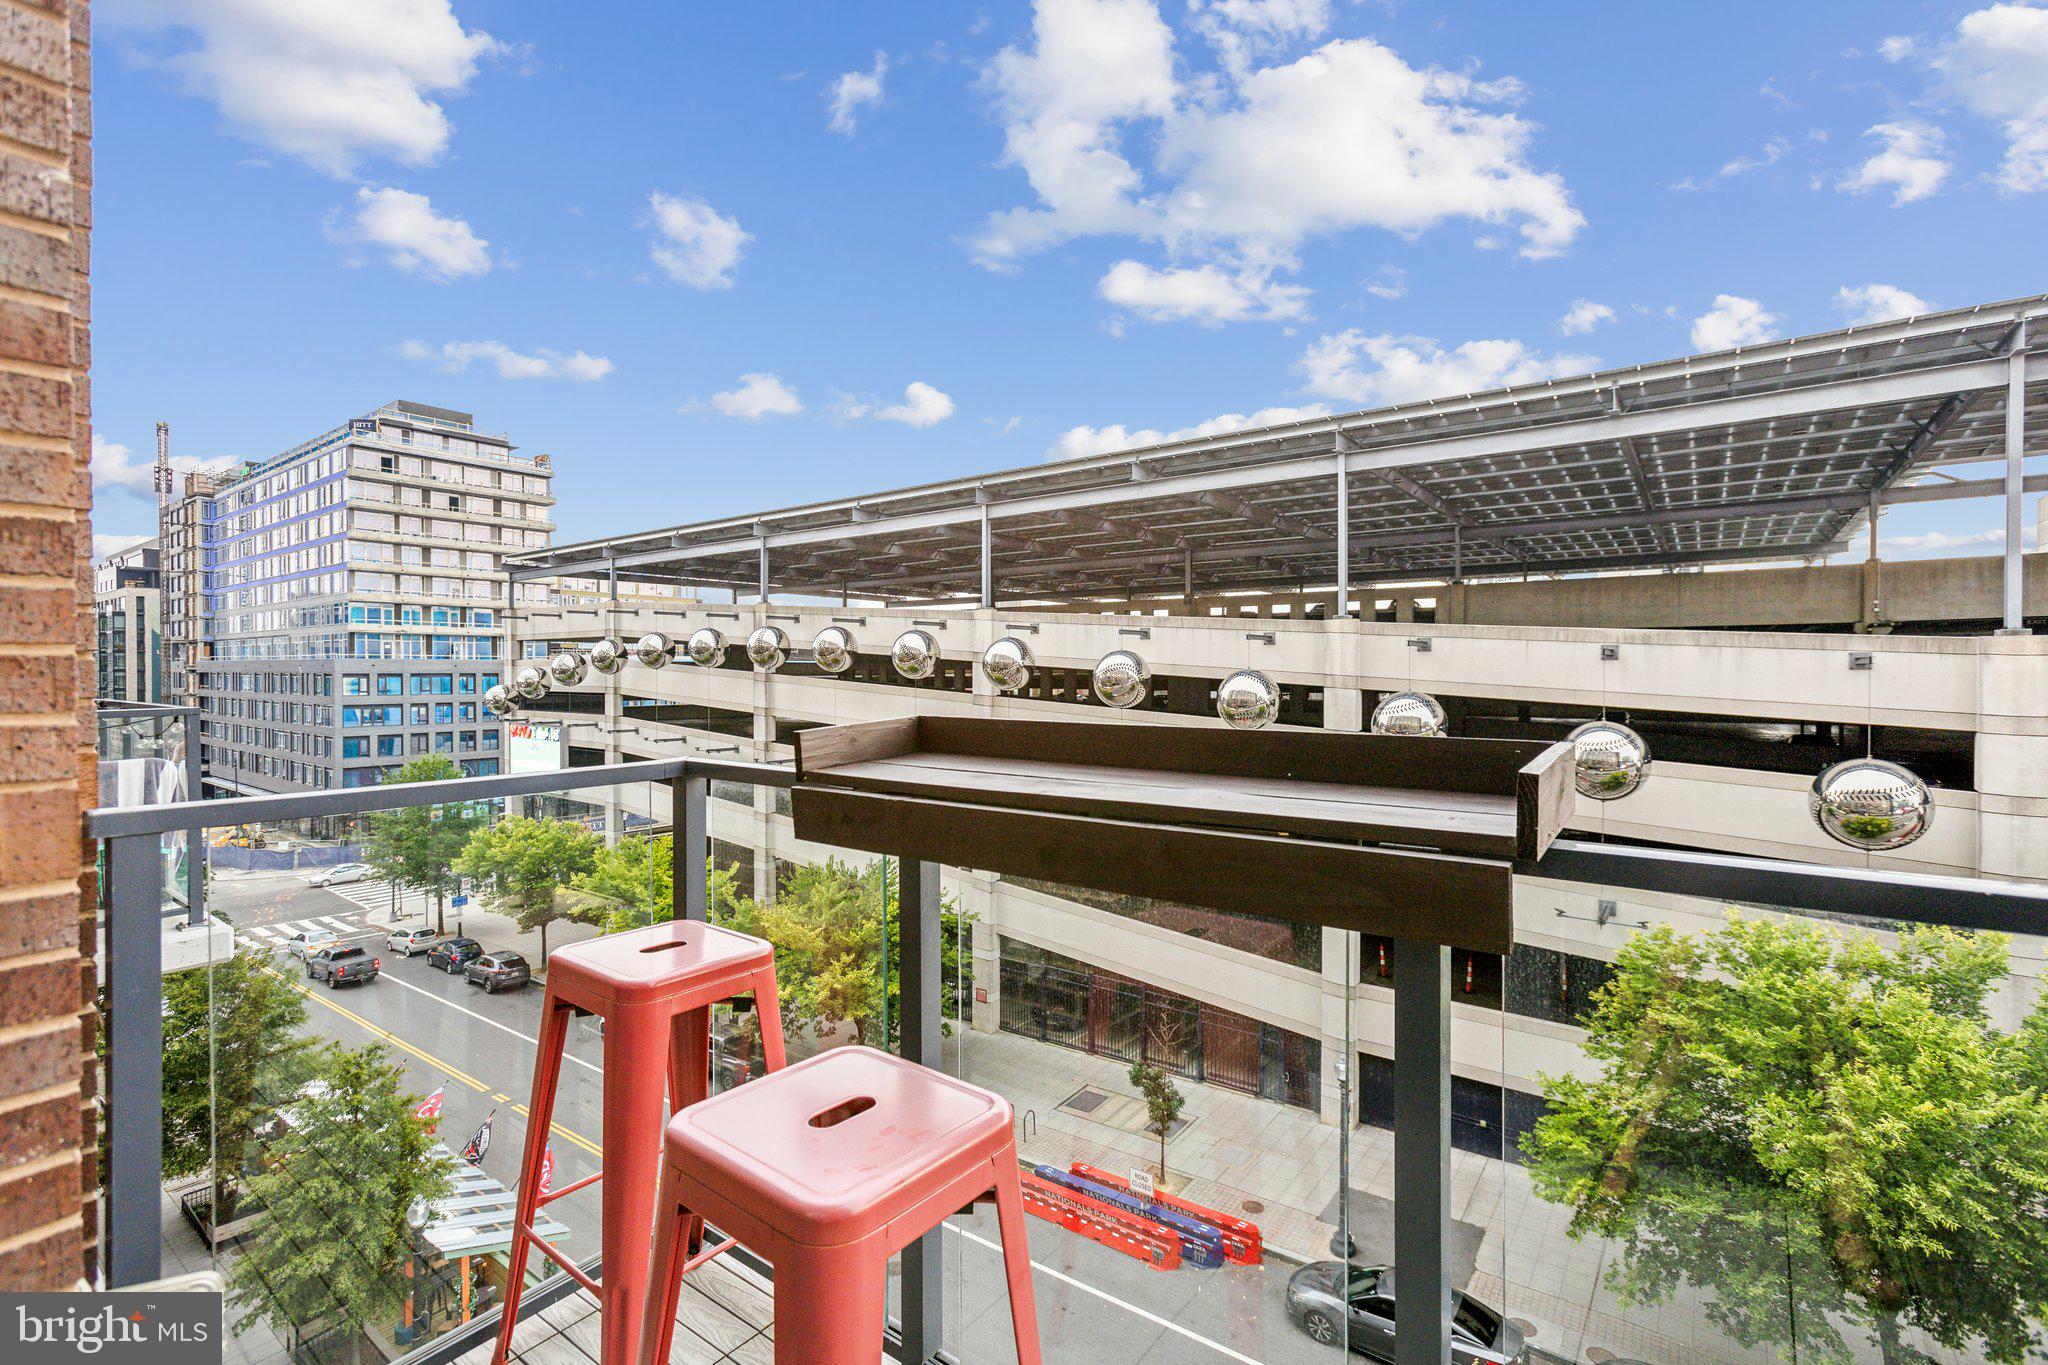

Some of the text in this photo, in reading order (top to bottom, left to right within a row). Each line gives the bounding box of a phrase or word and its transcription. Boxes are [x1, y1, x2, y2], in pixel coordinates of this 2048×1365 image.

[1134, 1172, 1149, 1183] ROAD
[1131, 1180, 1152, 1192] CLOSED
[1044, 1190, 1118, 1224] NATIONALS PARK
[1082, 1188, 1159, 1223] NATIONALS PARK
[1170, 1204, 1198, 1220] PARK
